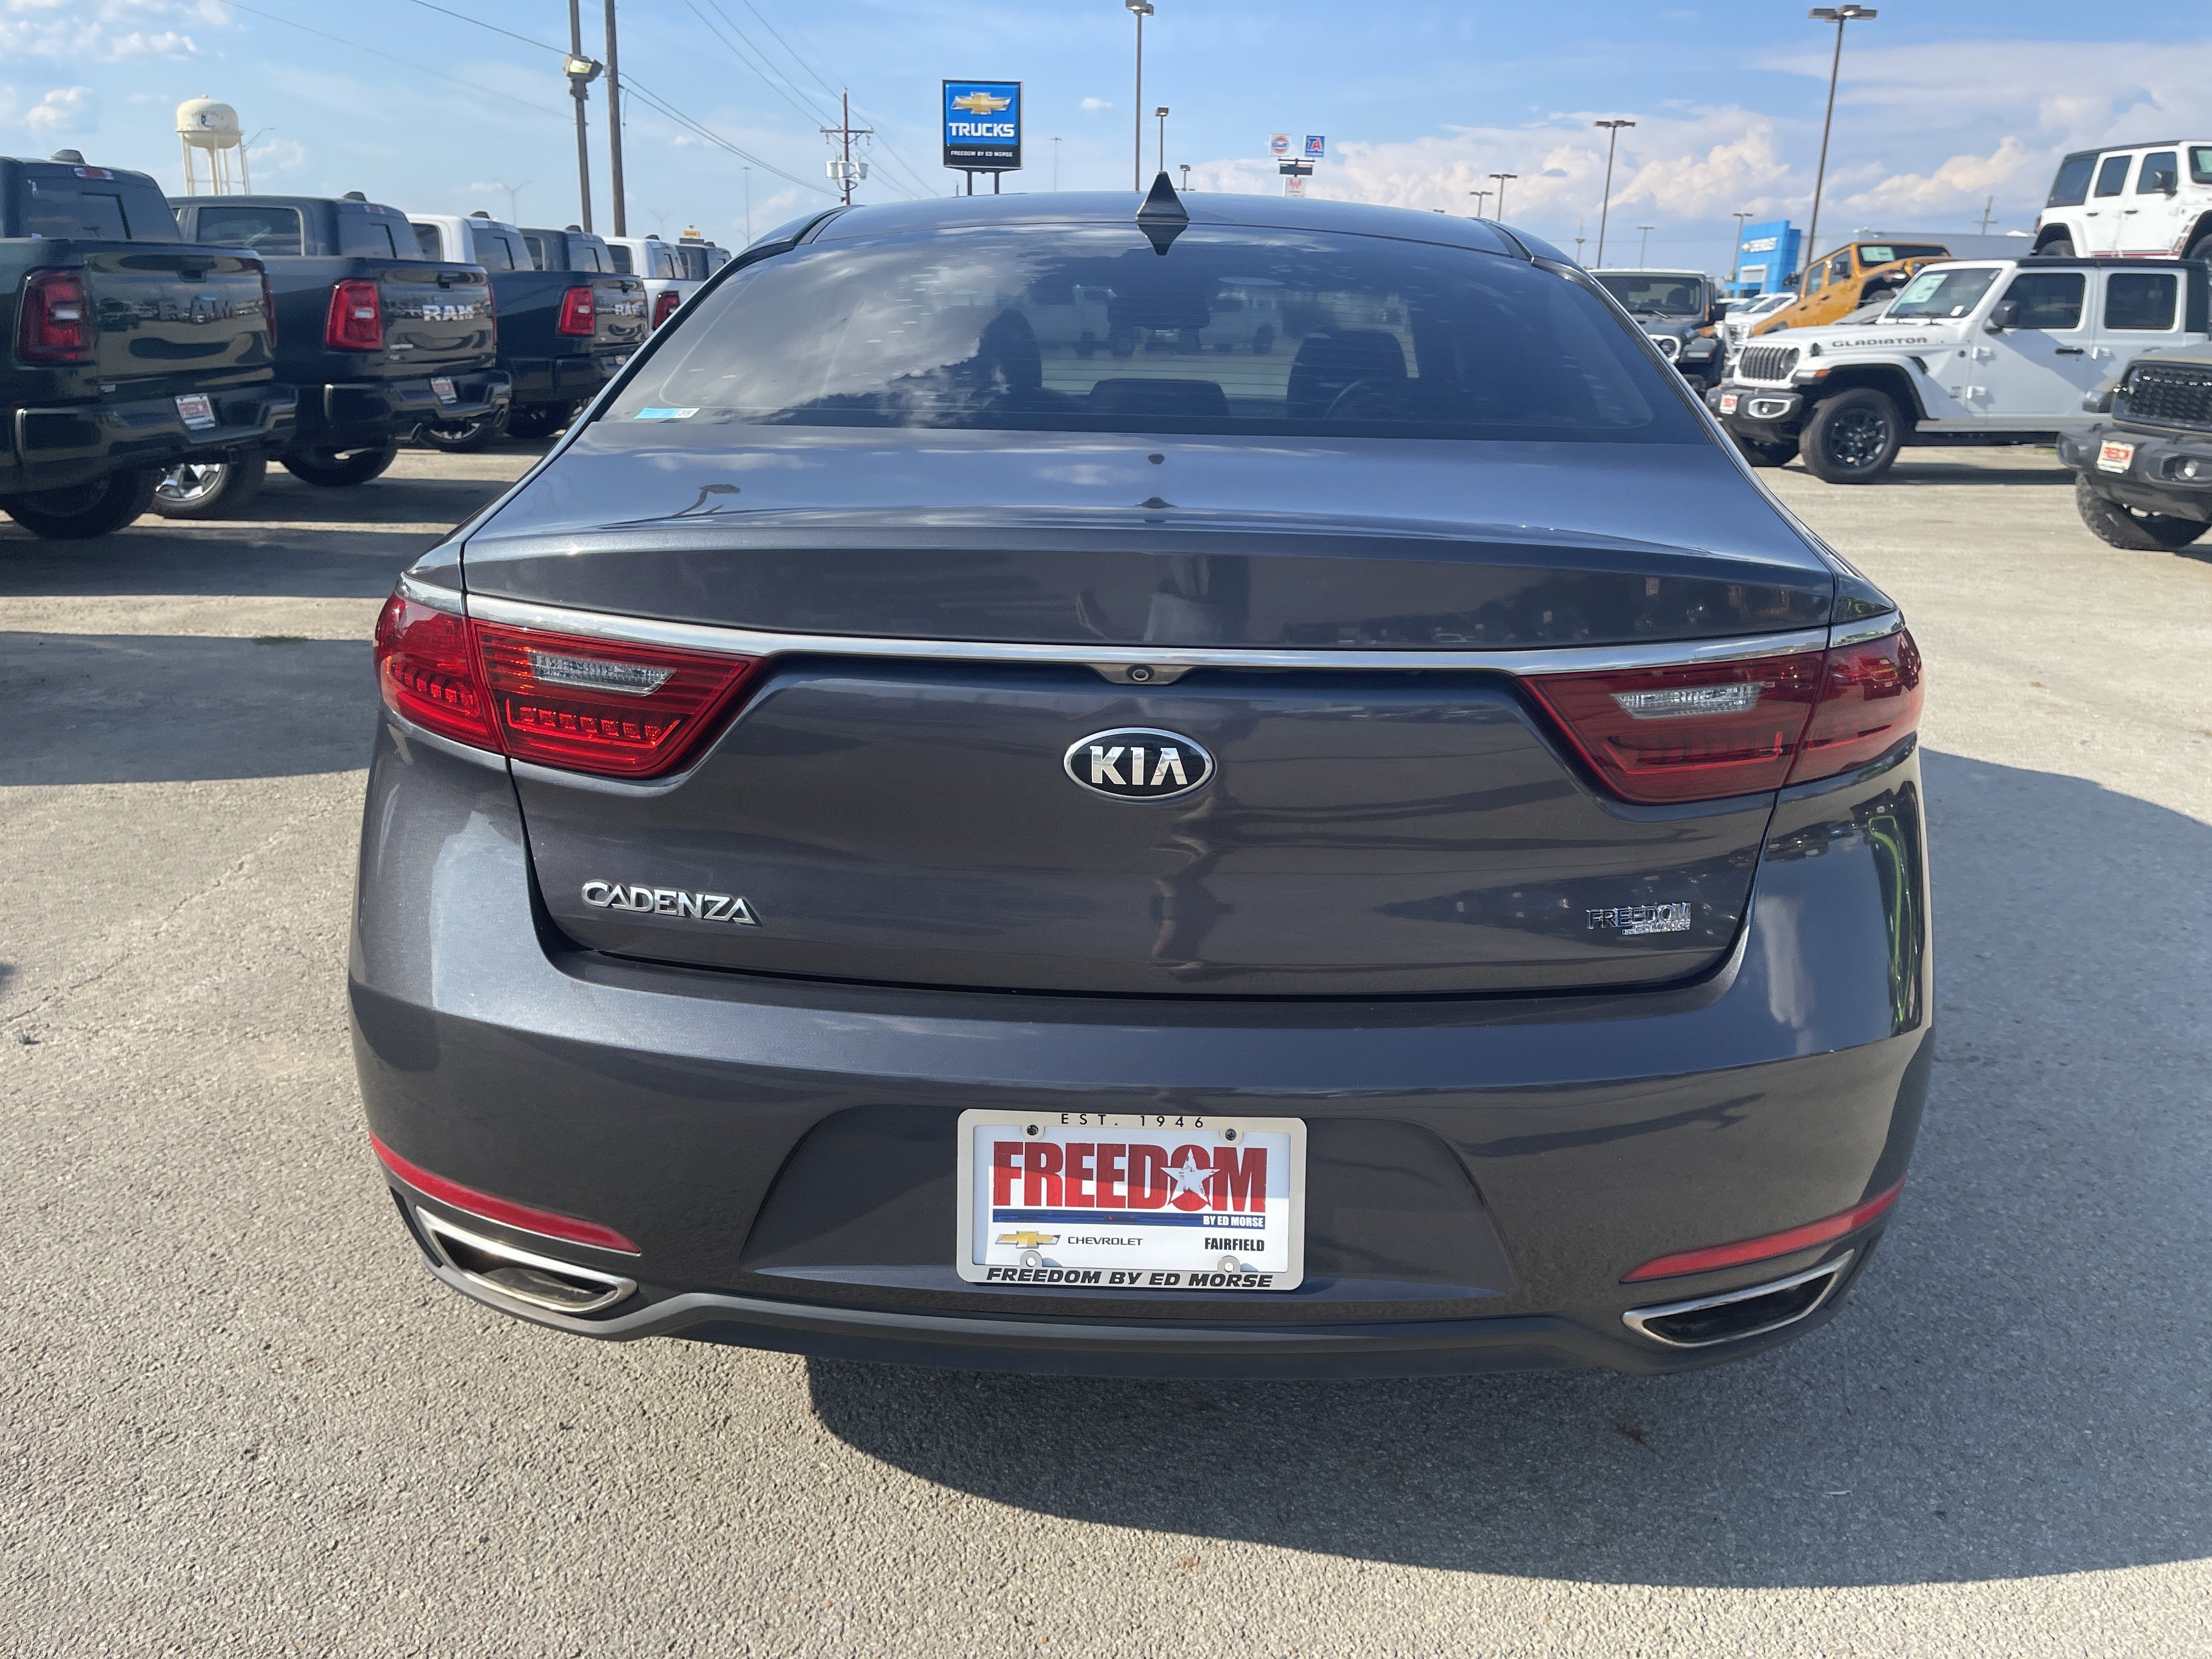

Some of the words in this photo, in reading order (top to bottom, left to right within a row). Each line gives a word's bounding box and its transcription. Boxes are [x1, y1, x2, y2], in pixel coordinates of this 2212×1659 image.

[949, 122, 1015, 137] TRUCKS
[1307, 137, 1323, 151] TA
[422, 304, 473, 321] RAM
[1832, 337, 1928, 347] GLADIATOR
[1090, 746, 1188, 786] KIA
[582, 881, 757, 926] CADENZA
[1585, 903, 1691, 929] FREEDOM
[1061, 1113, 1118, 1126] EST.
[1140, 1115, 1204, 1128] 1946
[993, 1141, 1268, 1212] FREEDOM
[1203, 1215, 1216, 1226] BY
[1217, 1216, 1229, 1226] ED
[1231, 1216, 1264, 1227] MORSE
[1068, 1236, 1144, 1246] CHEVROLET
[1204, 1237, 1265, 1252] FAIRFIELD
[986, 1267, 1102, 1284] FREEDOM
[1109, 1272, 1143, 1285] BY
[1149, 1273, 1181, 1285] ED
[1188, 1273, 1273, 1288] MORSE
